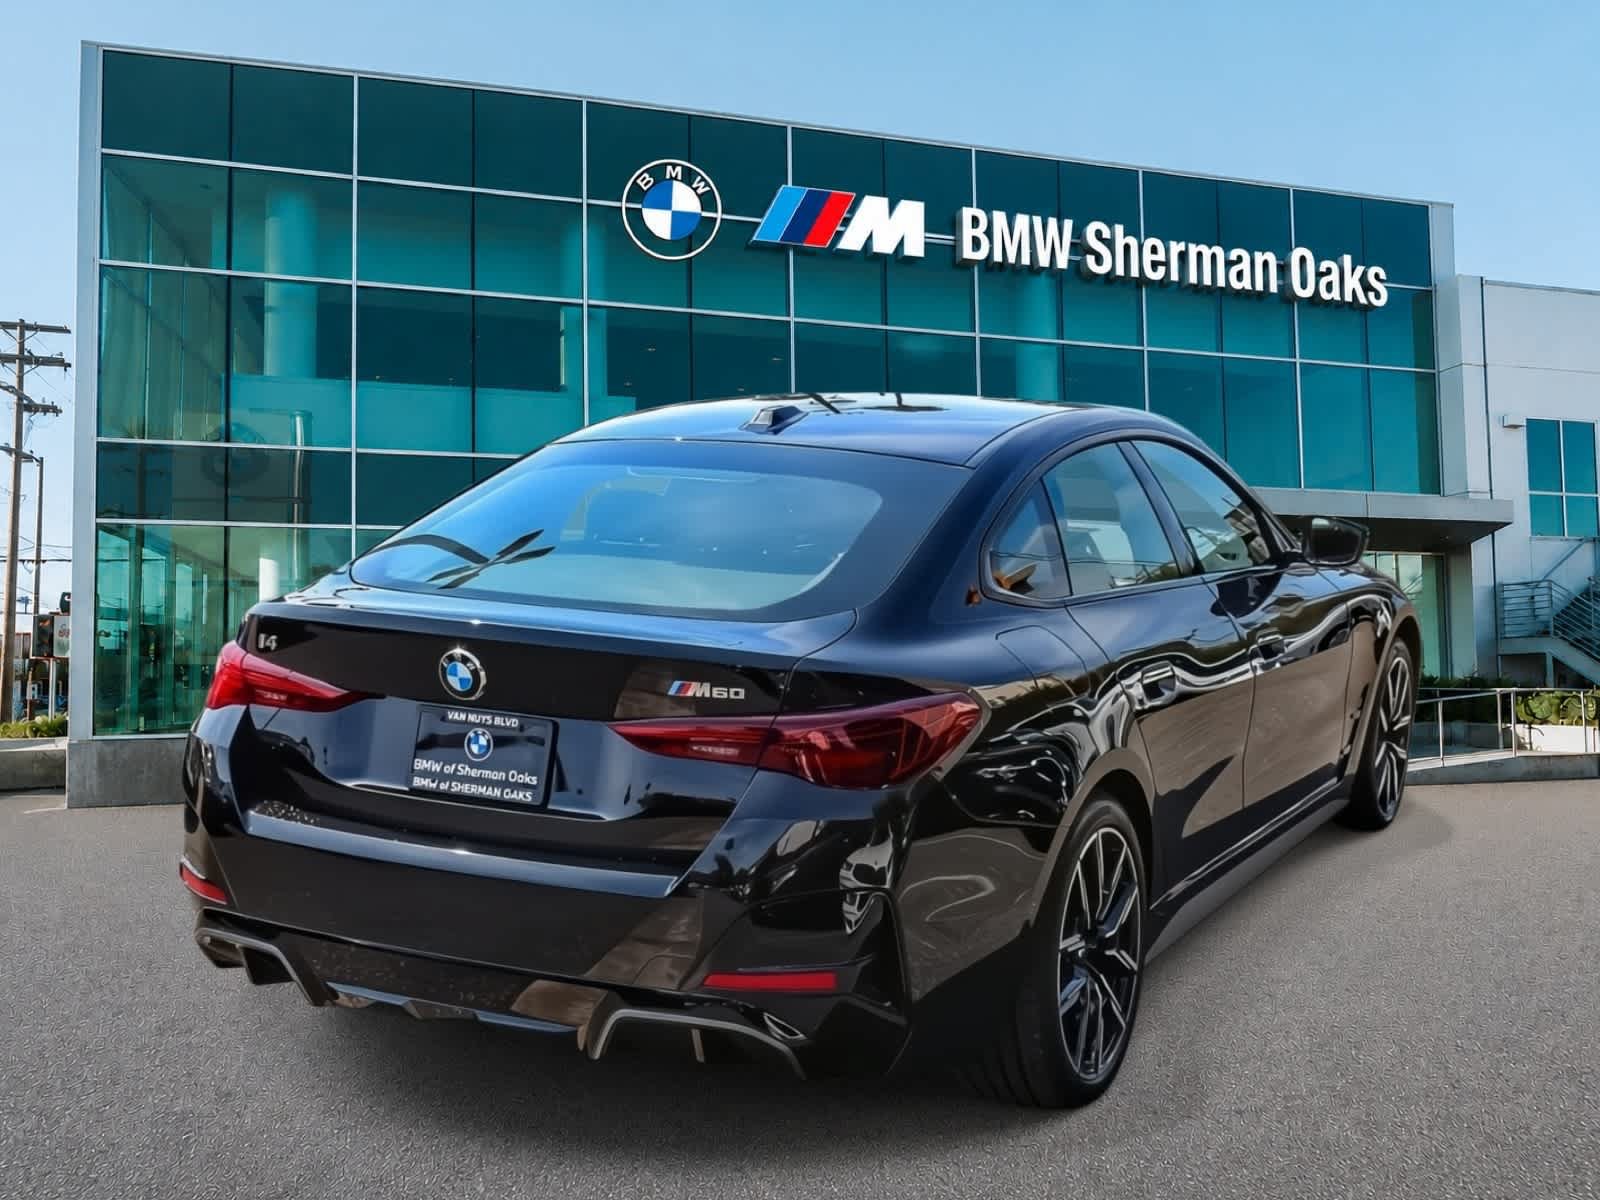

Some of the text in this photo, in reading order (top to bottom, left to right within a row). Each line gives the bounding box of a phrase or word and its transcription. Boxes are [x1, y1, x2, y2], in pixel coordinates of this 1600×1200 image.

[636, 165, 710, 195] BMW
[836, 195, 925, 257] M
[960, 206, 1388, 308] BMW Sherman Oaks
[447, 711, 519, 728] VAN NUYS BLVD
[413, 758, 538, 785] BMW of Sherman Oaks
[412, 776, 533, 802] BMW of SHERMAN OAKS
